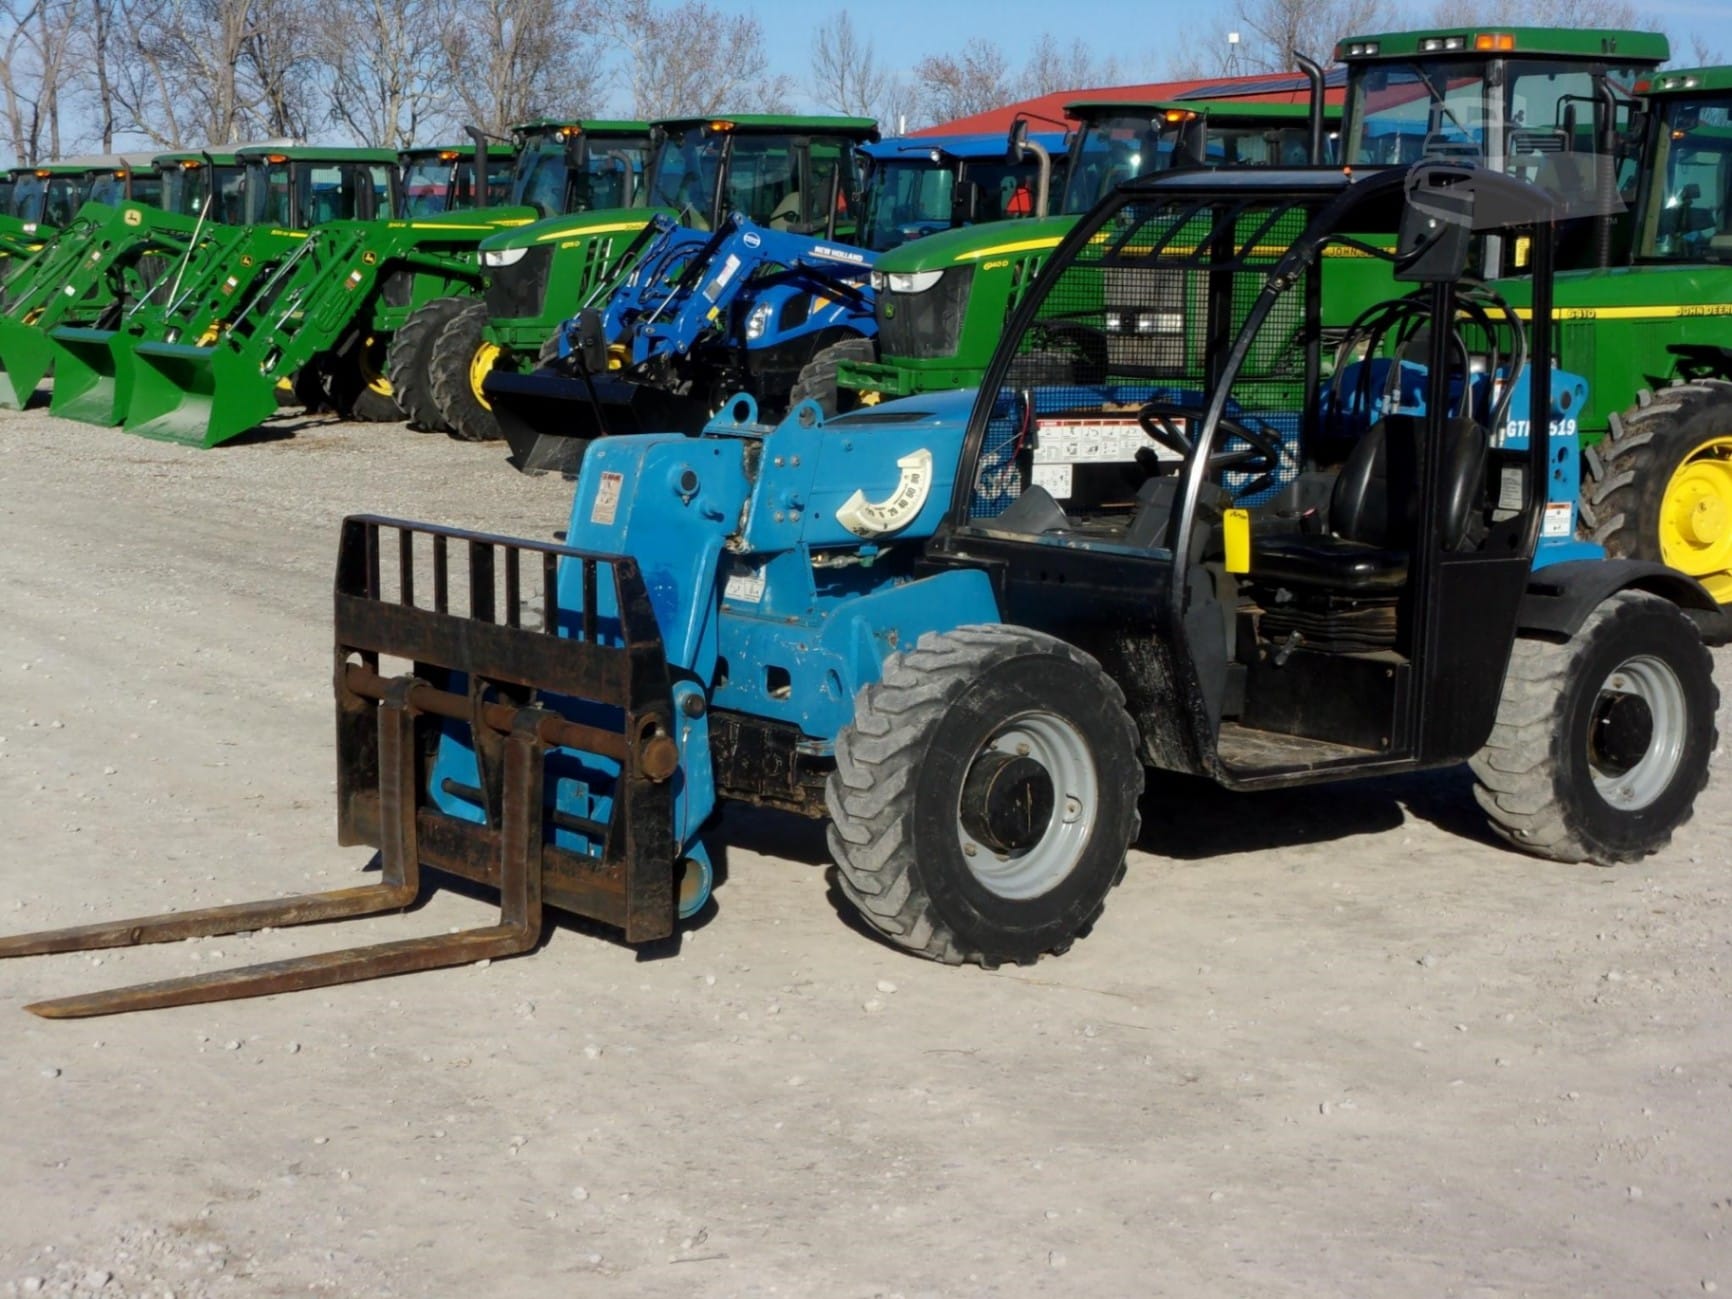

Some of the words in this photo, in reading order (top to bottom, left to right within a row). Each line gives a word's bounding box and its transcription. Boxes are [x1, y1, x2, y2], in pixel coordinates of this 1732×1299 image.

[814, 246, 831, 256] NEW
[832, 250, 864, 262] HOLLAND
[1676, 305, 1704, 317] JOHN
[1704, 303, 1732, 316] DEER
